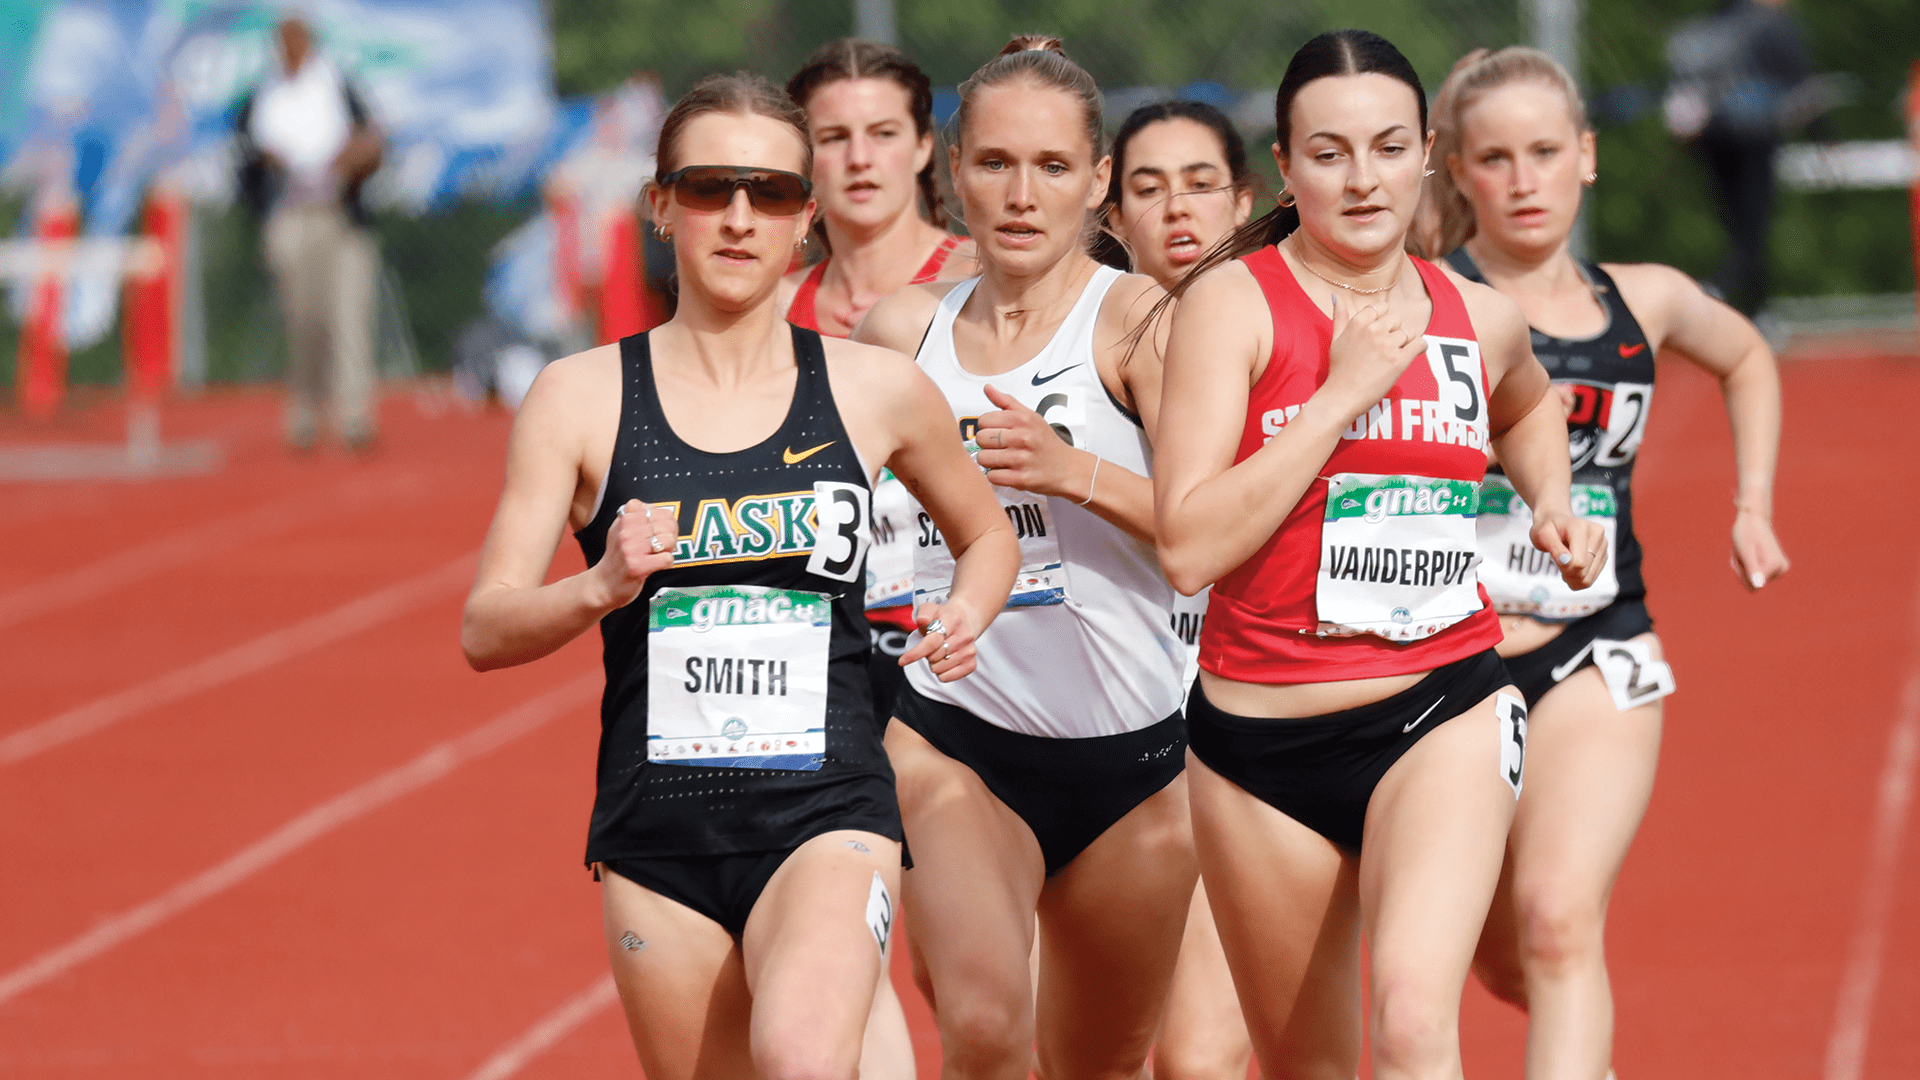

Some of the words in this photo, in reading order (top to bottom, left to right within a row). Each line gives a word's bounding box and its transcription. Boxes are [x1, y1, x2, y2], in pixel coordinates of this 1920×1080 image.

[1439, 343, 1479, 422] 5
[1262, 397, 1393, 446] SON
[1607, 391, 1643, 459] 2
[1363, 486, 1452, 524] gnac
[822, 488, 861, 575] 3
[1329, 545, 1475, 587] VANDERPUT
[690, 595, 793, 633] gnac
[684, 656, 787, 696] SMITH
[1608, 647, 1660, 700] 2
[1508, 702, 1528, 788] 5
